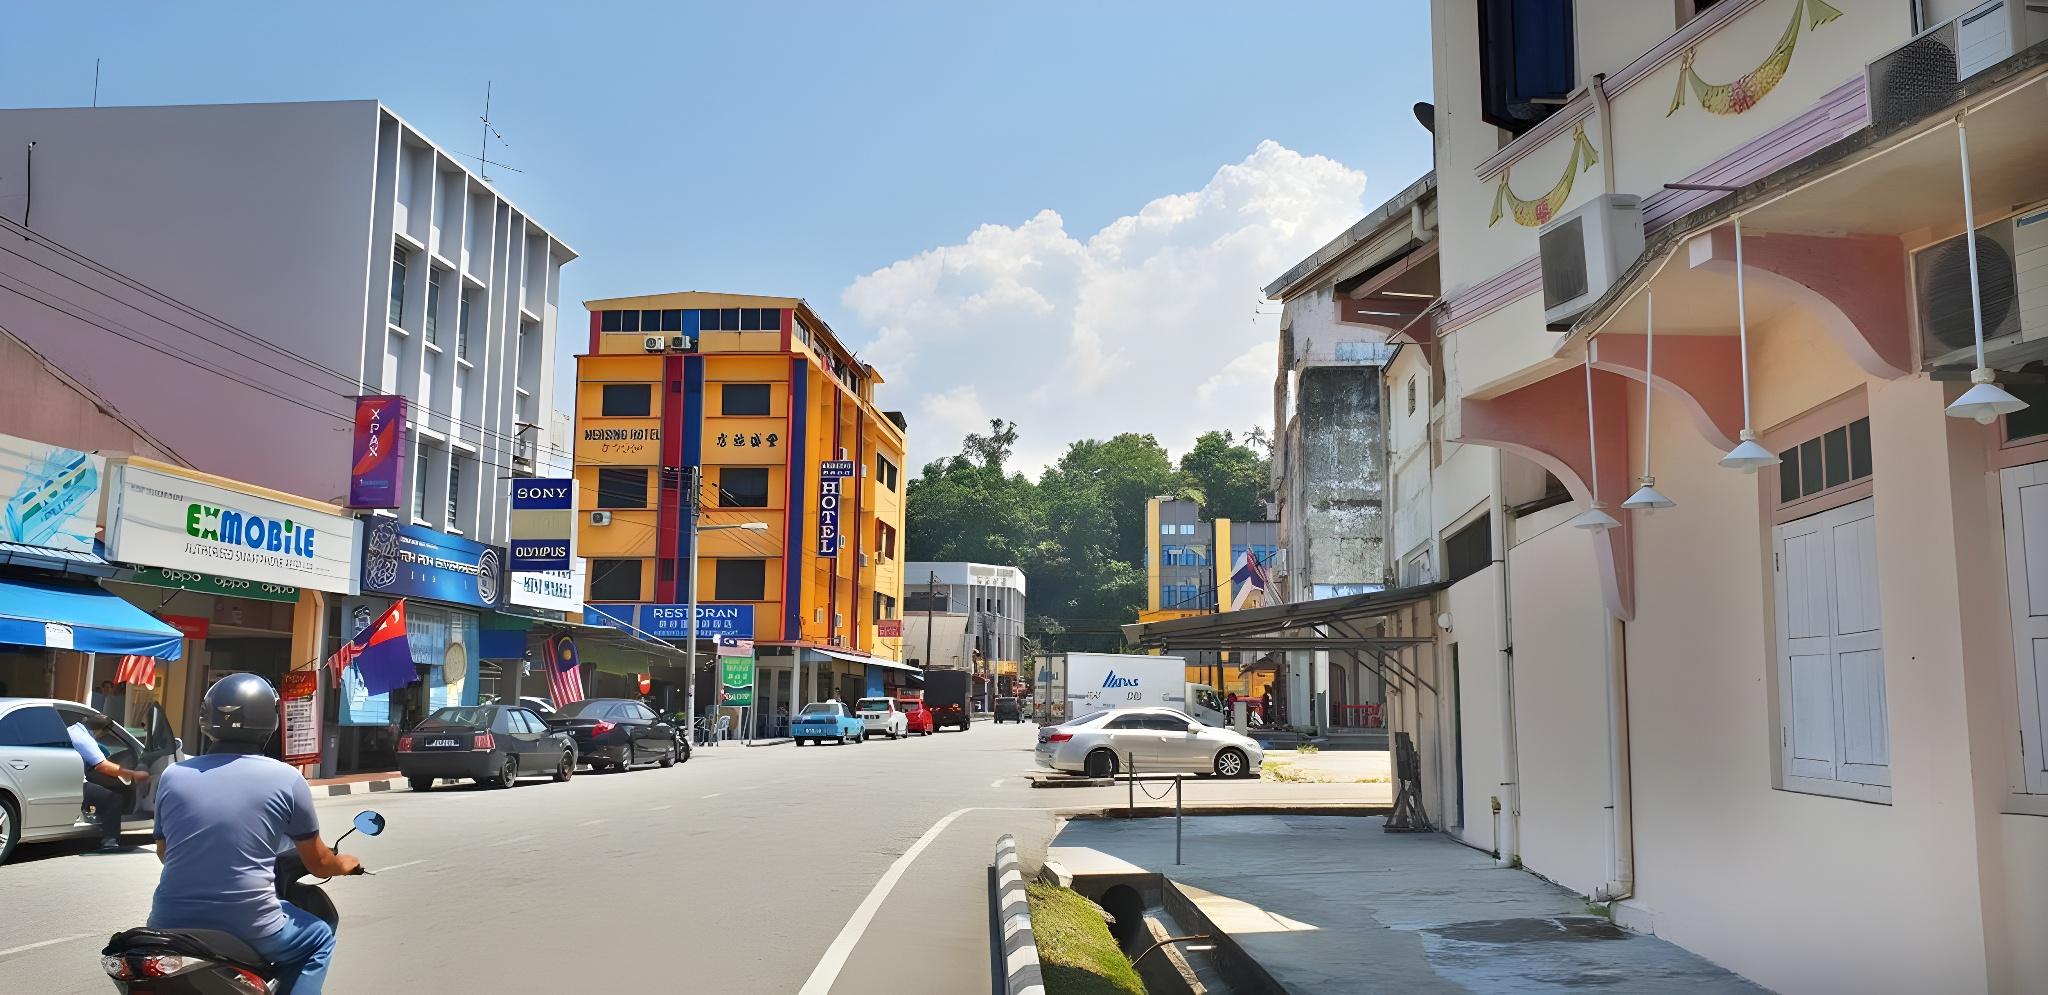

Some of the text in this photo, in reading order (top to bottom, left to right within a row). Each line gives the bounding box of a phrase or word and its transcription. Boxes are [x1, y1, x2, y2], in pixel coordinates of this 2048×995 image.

[369, 408, 381, 457] XPAX
[517, 487, 567, 499] SONY
[820, 482, 839, 553] HOTEL
[515, 546, 566, 558] OLYMPUS
[653, 608, 738, 618] RESTORAN
